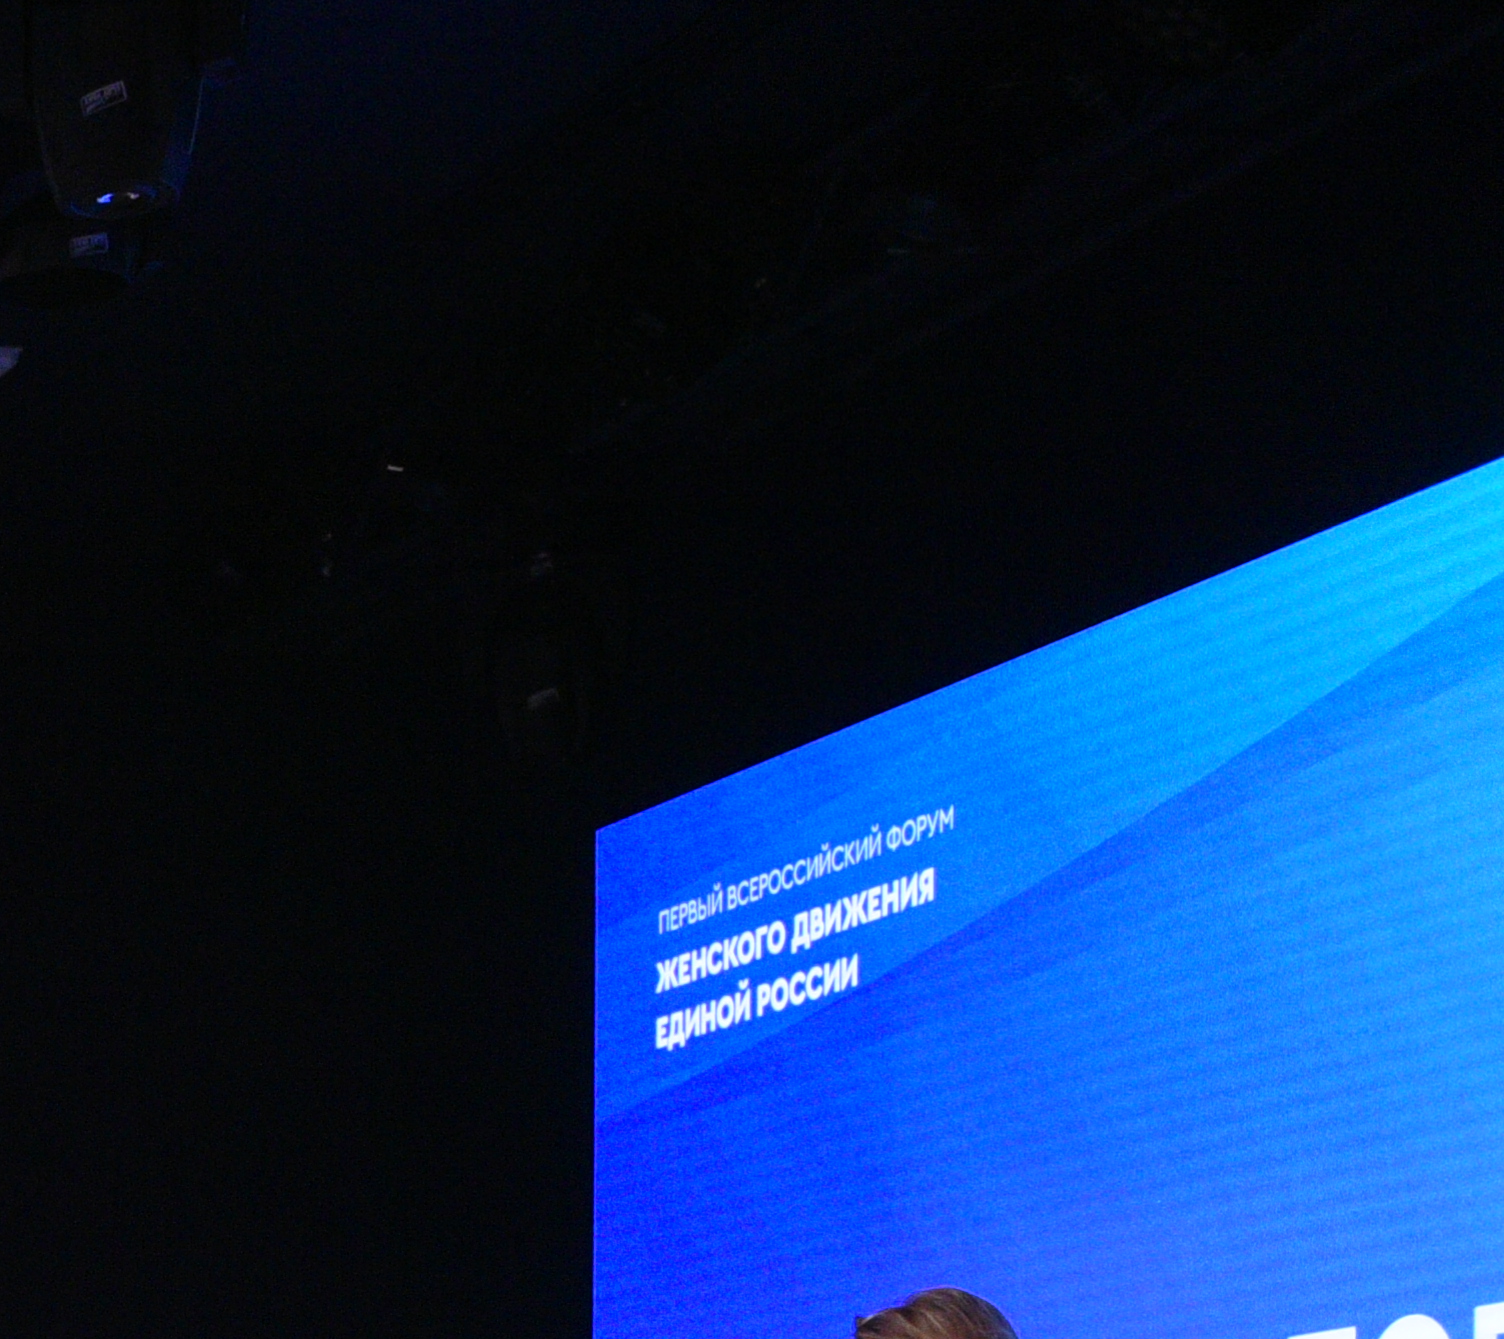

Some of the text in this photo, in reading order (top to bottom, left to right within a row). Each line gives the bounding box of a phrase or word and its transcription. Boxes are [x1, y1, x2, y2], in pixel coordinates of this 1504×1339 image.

[654, 867, 937, 993] ЖЕНСКОГО ДВИЖЕНИЯ
[658, 805, 956, 935] ПЕРВЫЙ ВСЕРОССИЙСКИЙ ФОРУМ
[654, 953, 859, 1051] ЕДИНОЙ РОССИИ
